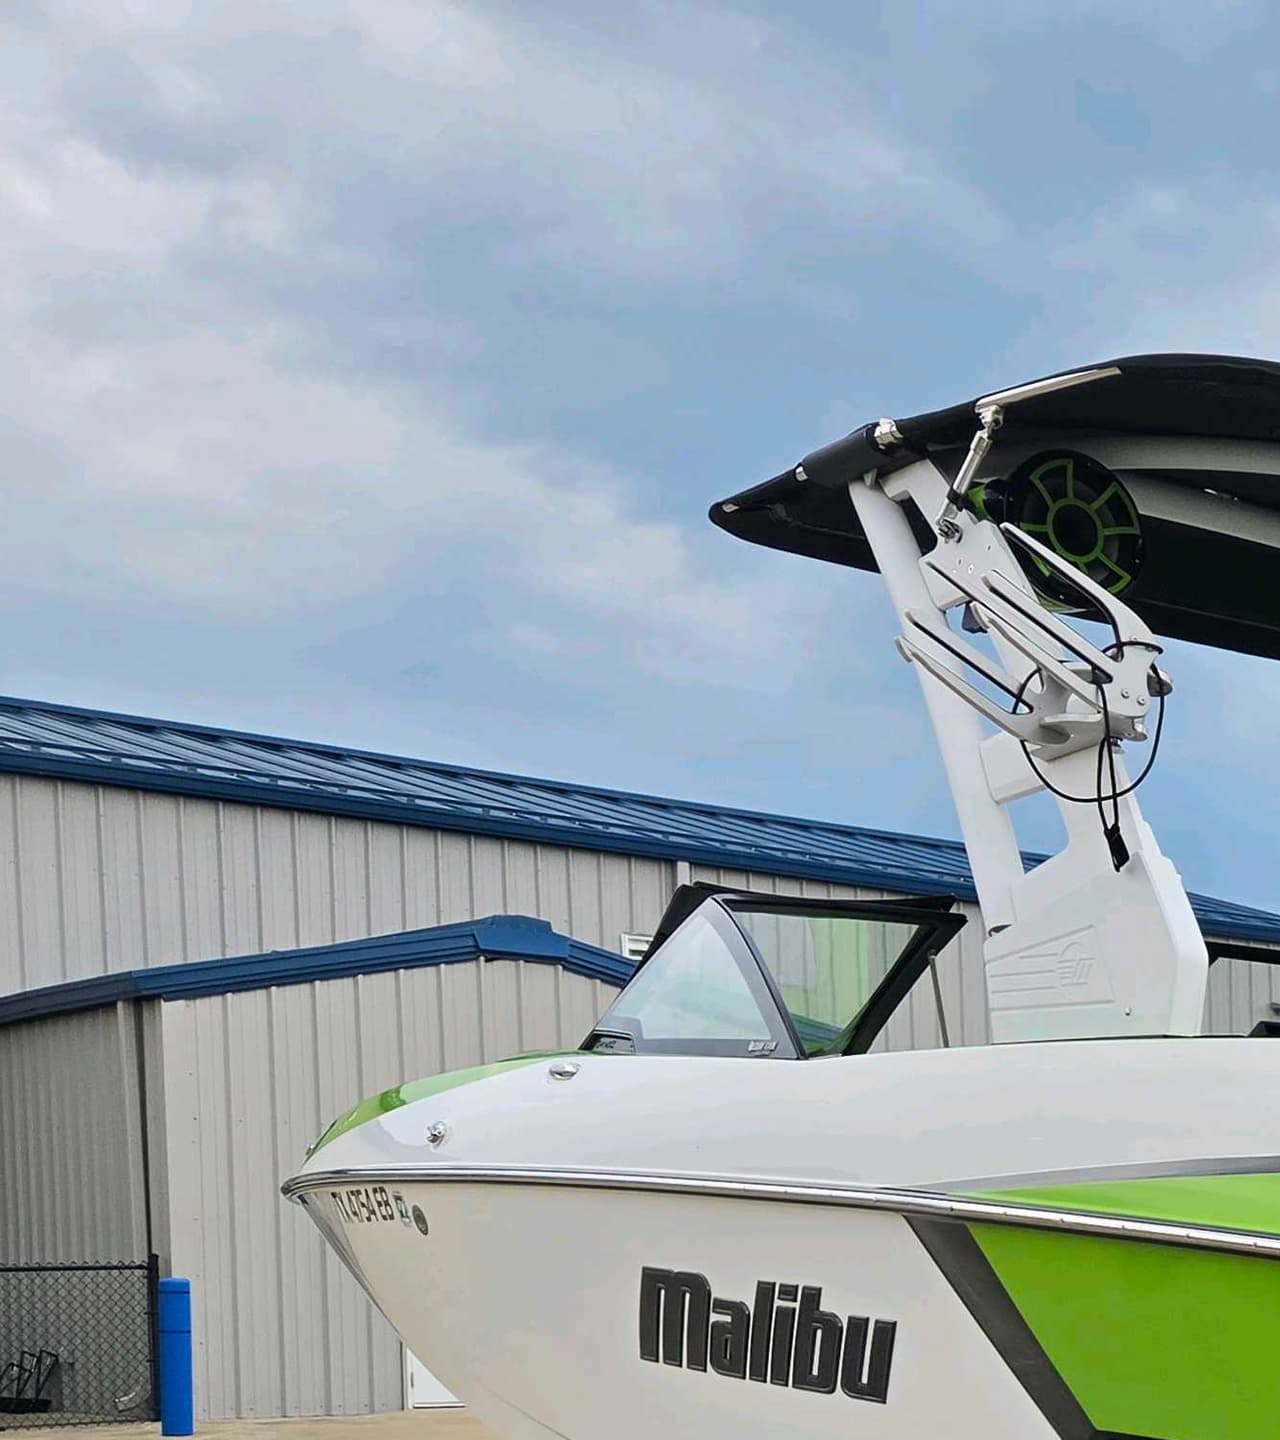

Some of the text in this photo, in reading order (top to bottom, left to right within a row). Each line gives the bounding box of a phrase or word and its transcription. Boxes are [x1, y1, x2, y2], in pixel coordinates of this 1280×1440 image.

[345, 1188, 380, 1223] 4754
[372, 1186, 395, 1221] EB
[639, 1266, 898, 1405] Malibu
